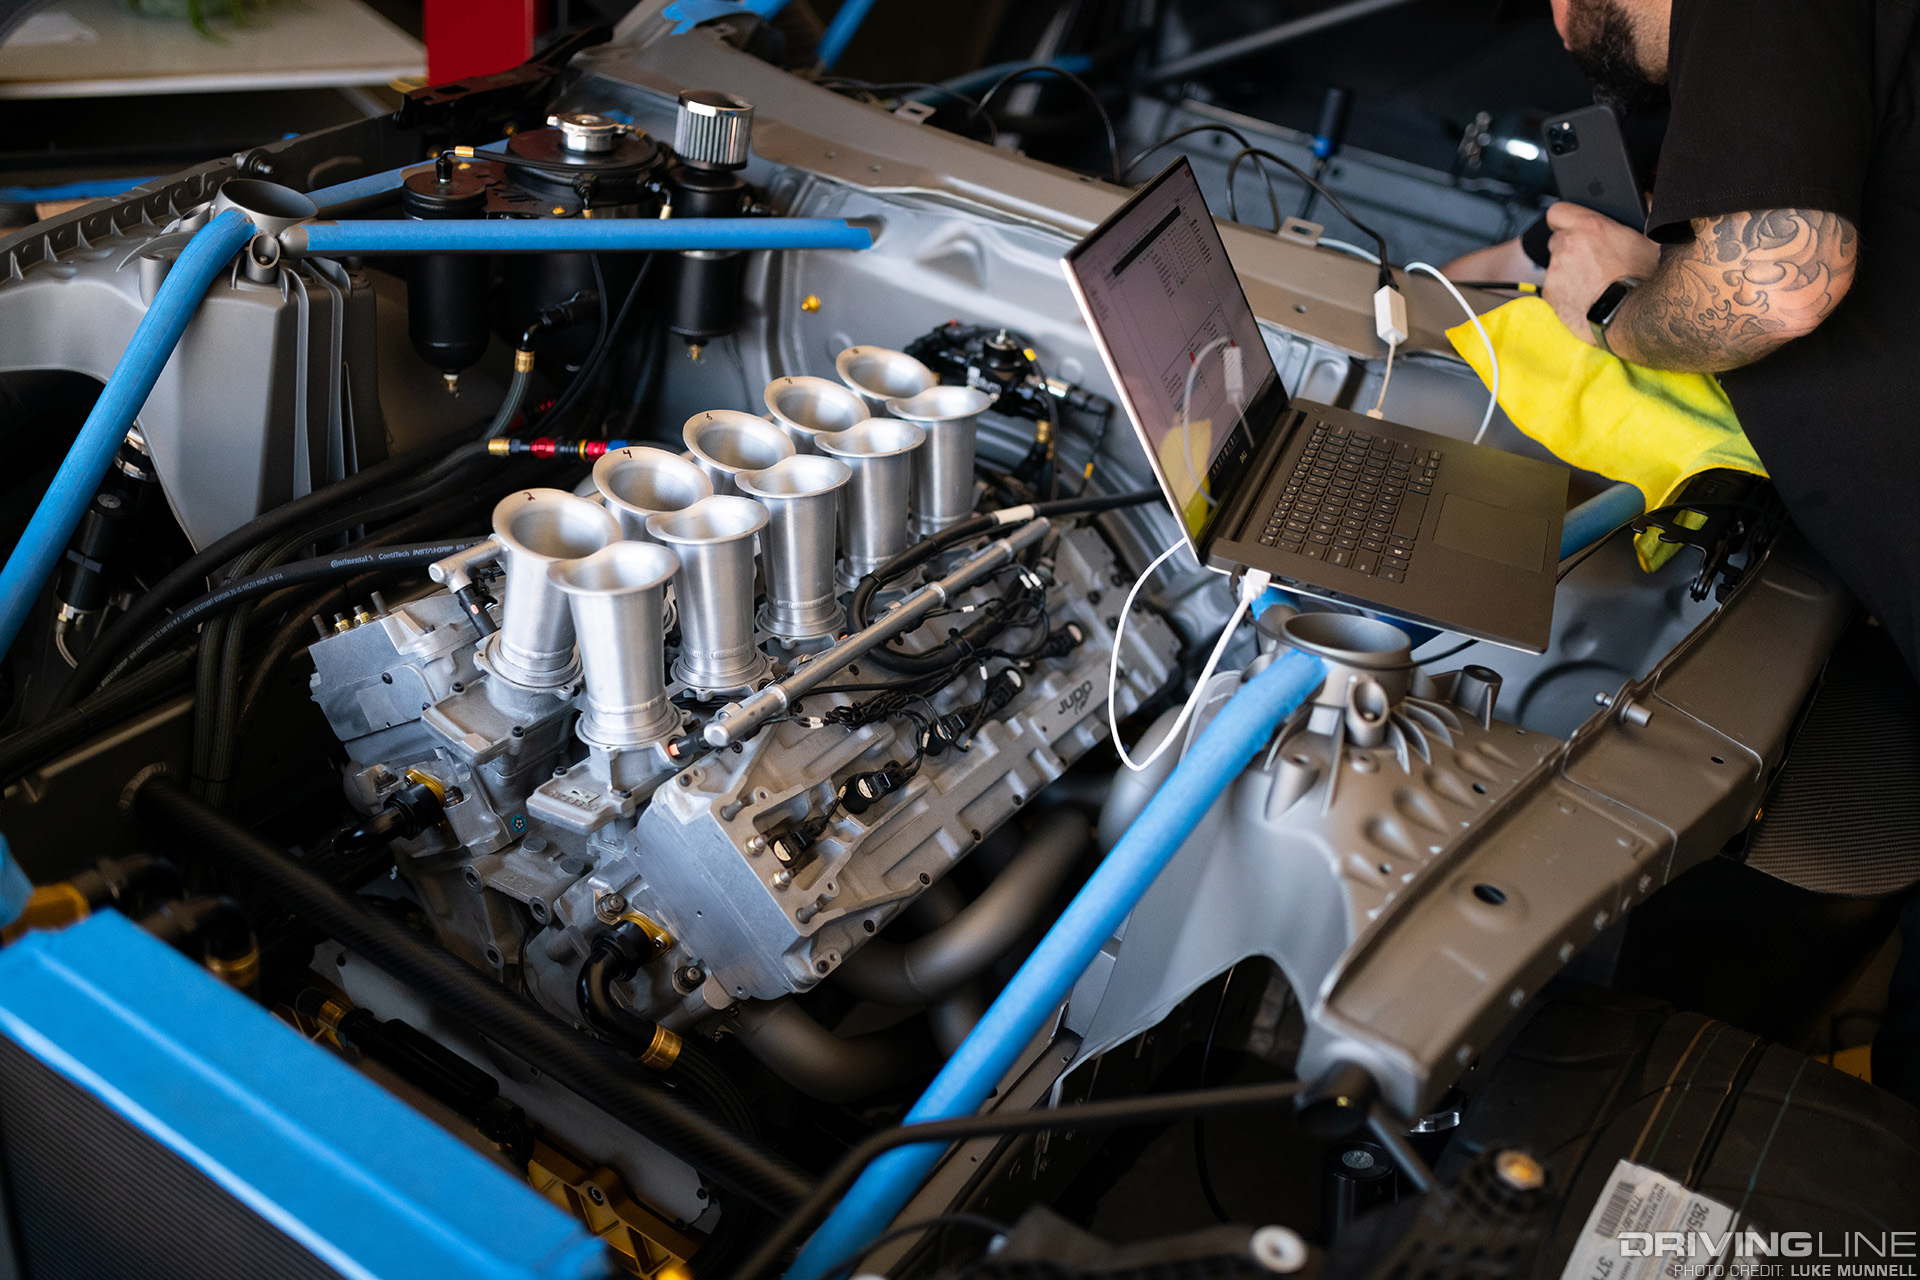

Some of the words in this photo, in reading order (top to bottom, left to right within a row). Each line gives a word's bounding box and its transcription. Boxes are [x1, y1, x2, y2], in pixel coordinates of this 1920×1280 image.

[622, 449, 632, 458] 4
[523, 492, 536, 501] 2
[330, 555, 368, 568] Continental
[379, 551, 410, 560] ContiTech
[1058, 680, 1093, 715] JUDD
